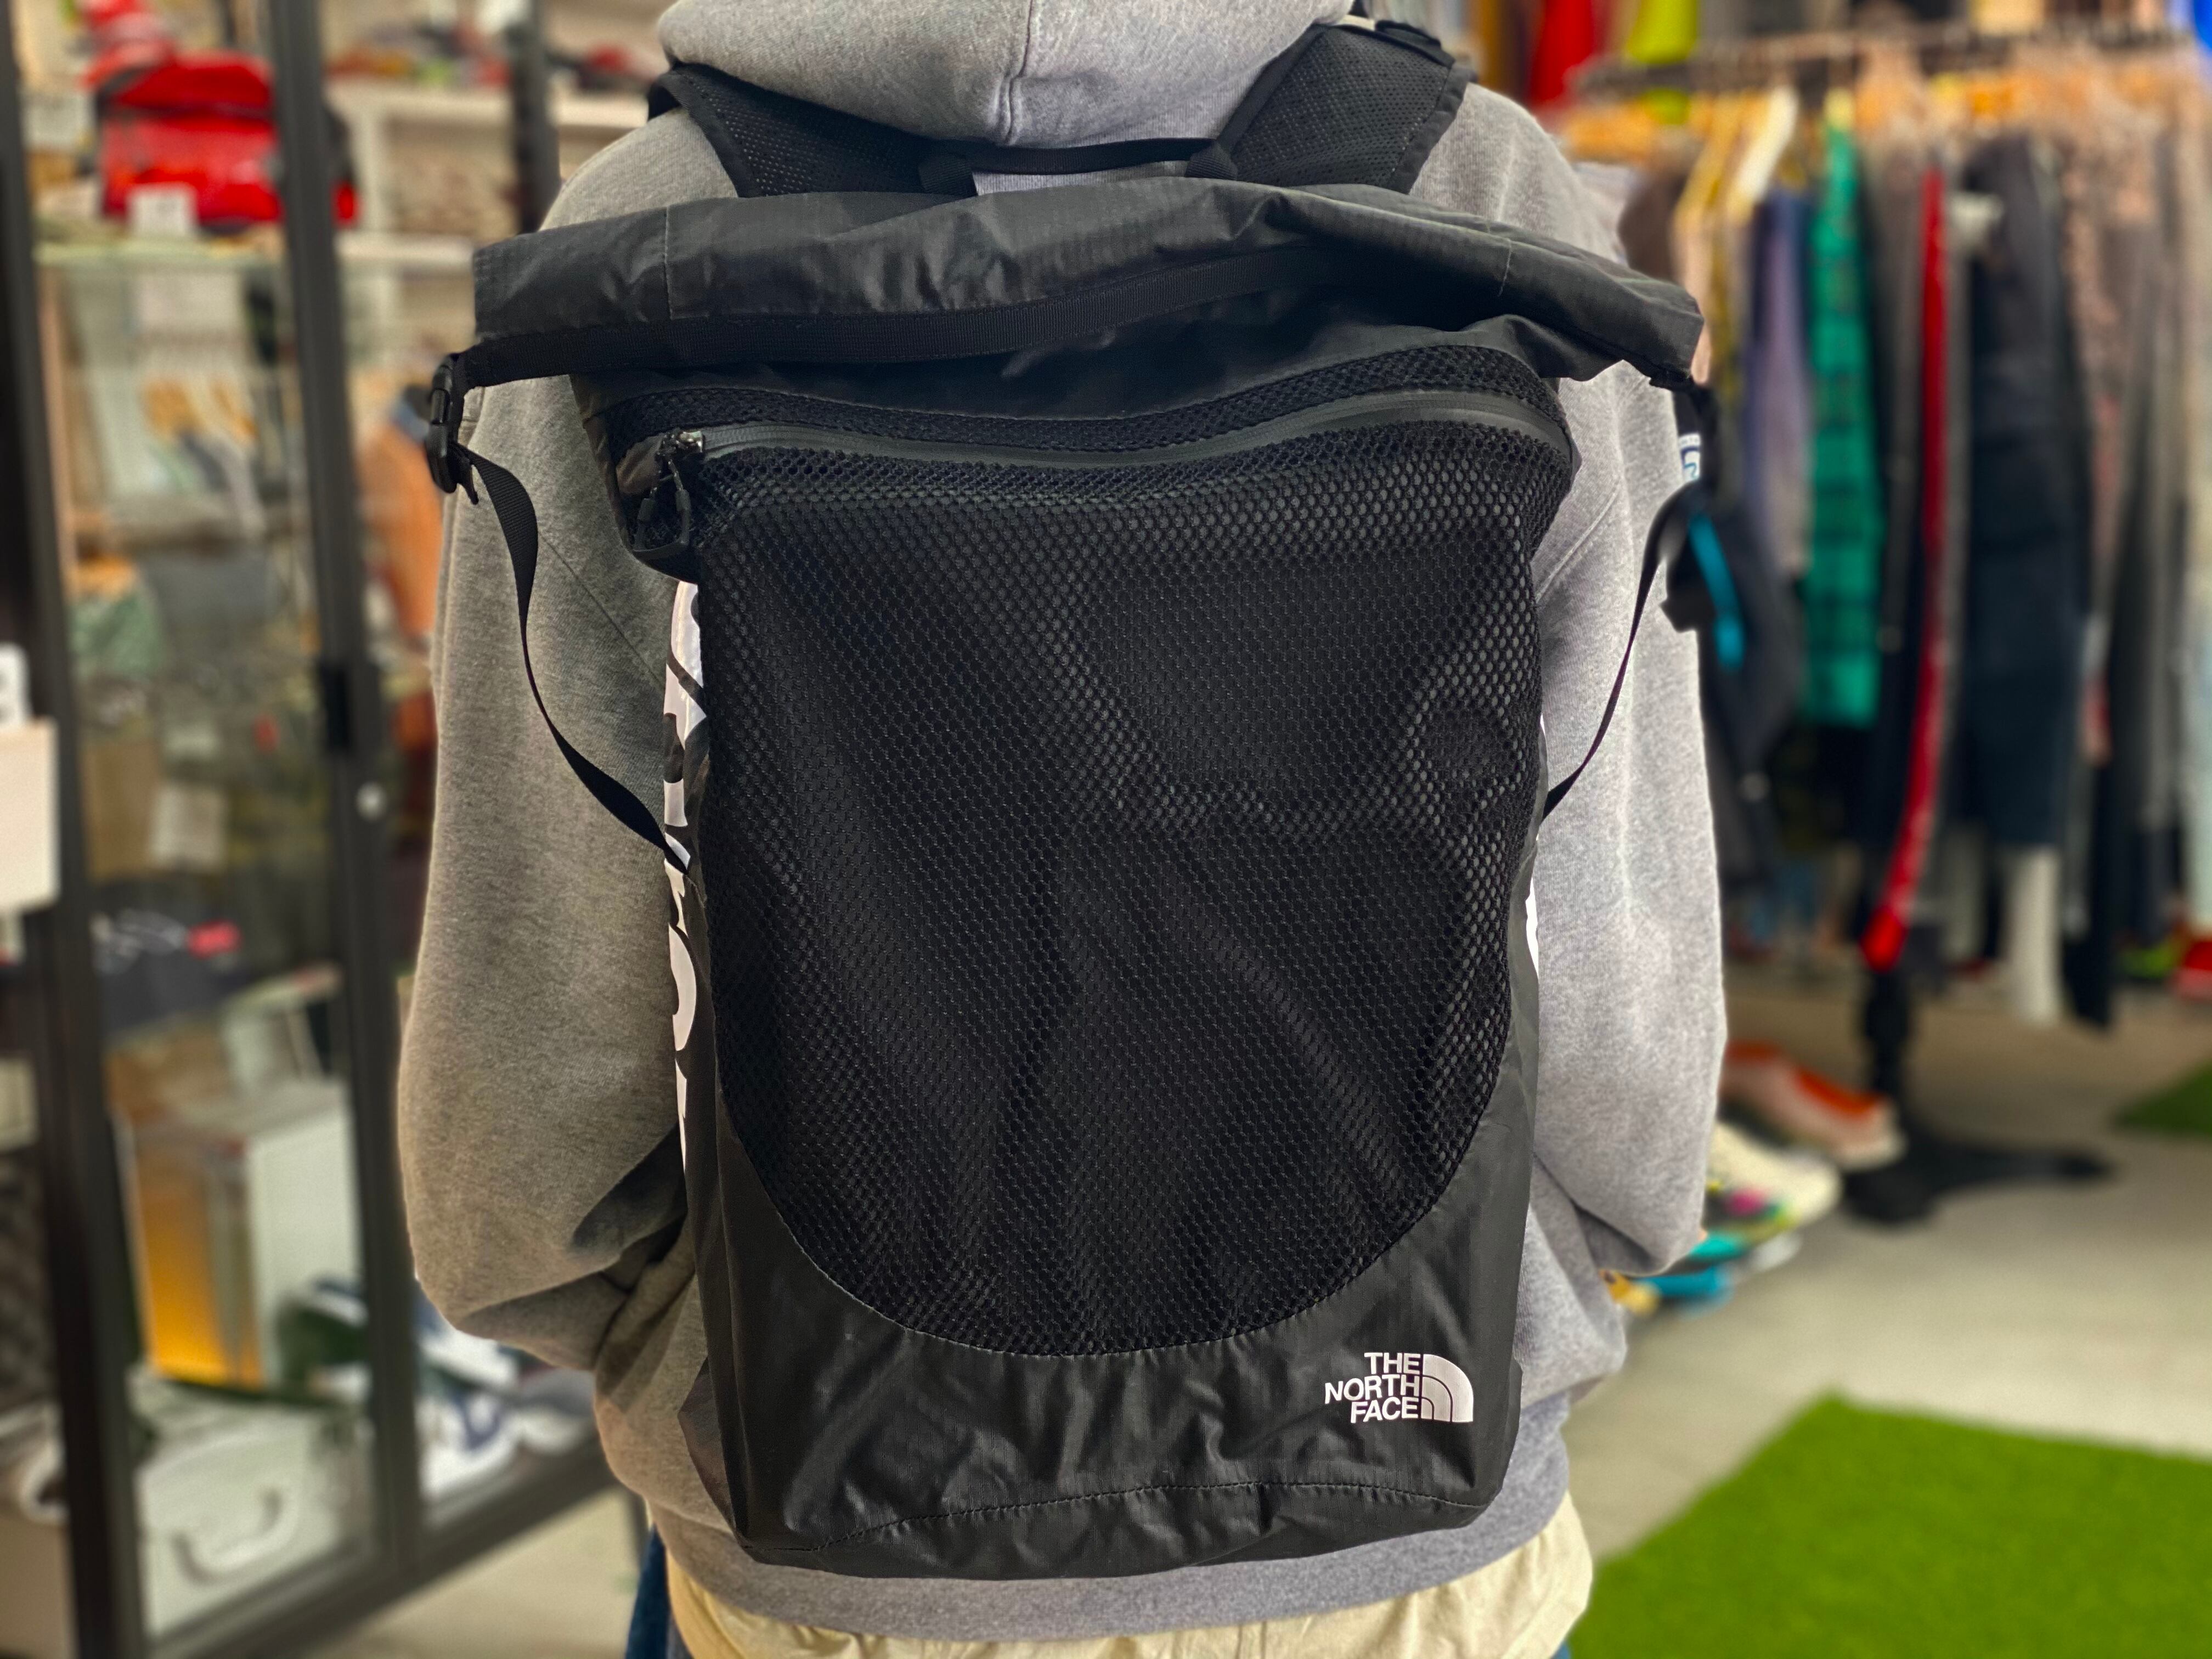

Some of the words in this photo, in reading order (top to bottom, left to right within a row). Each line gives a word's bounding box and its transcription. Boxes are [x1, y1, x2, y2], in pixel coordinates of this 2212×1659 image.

[1364, 1352, 1421, 1374] THE
[1324, 1374, 1420, 1404] NORTH
[1350, 1396, 1419, 1424] FACE
